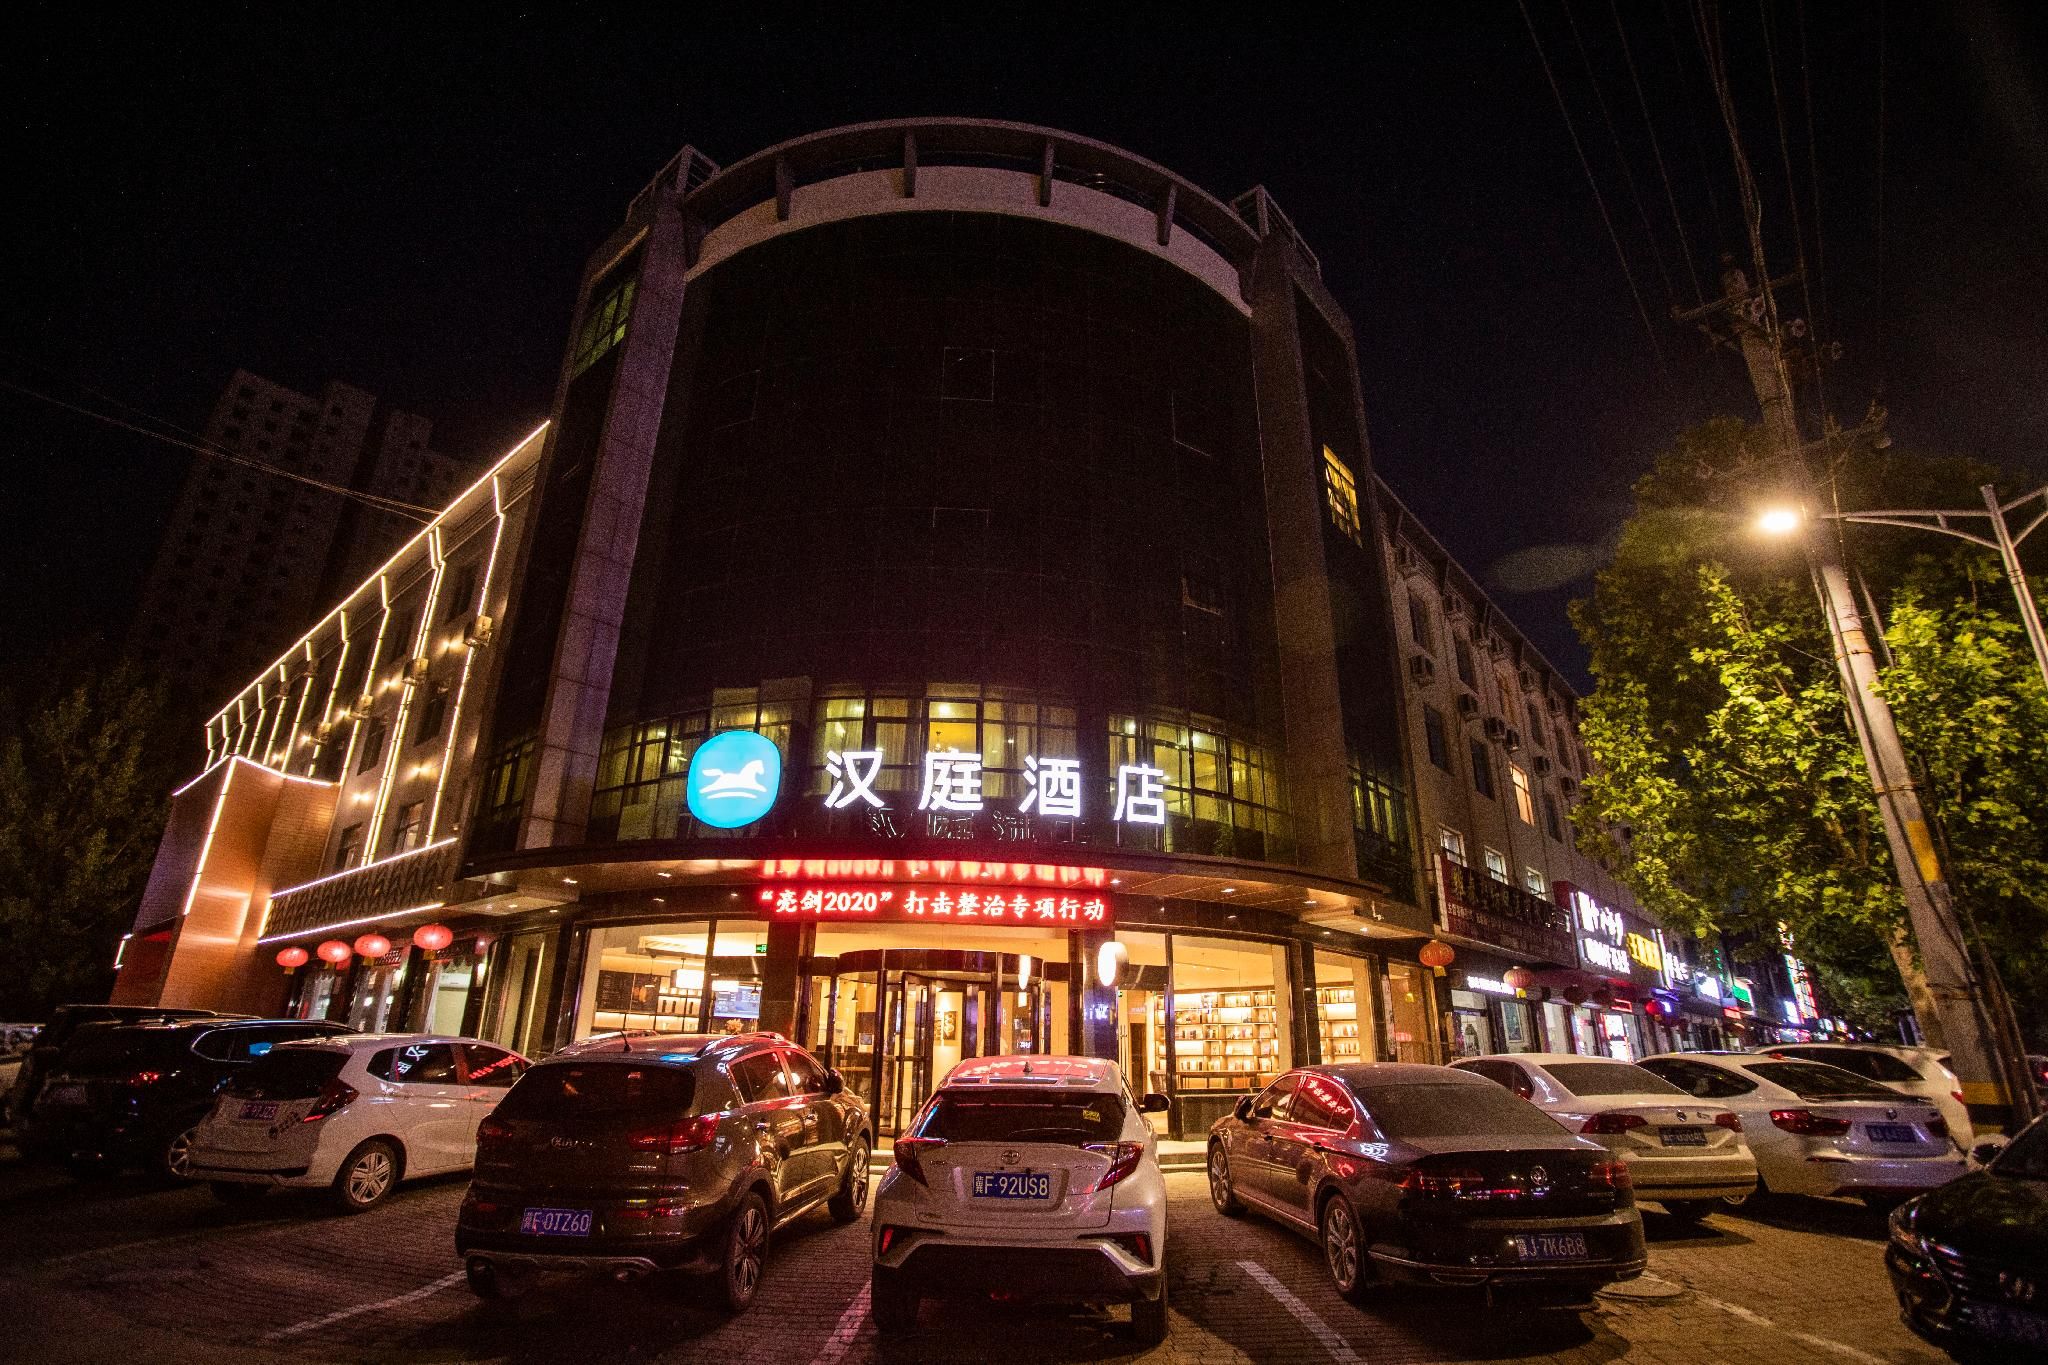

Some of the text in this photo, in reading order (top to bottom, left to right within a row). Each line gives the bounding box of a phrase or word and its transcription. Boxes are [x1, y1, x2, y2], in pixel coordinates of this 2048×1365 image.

[823, 749, 1166, 825] 汉庭酒店
[903, 890, 1106, 920] 打击整治专项行动
